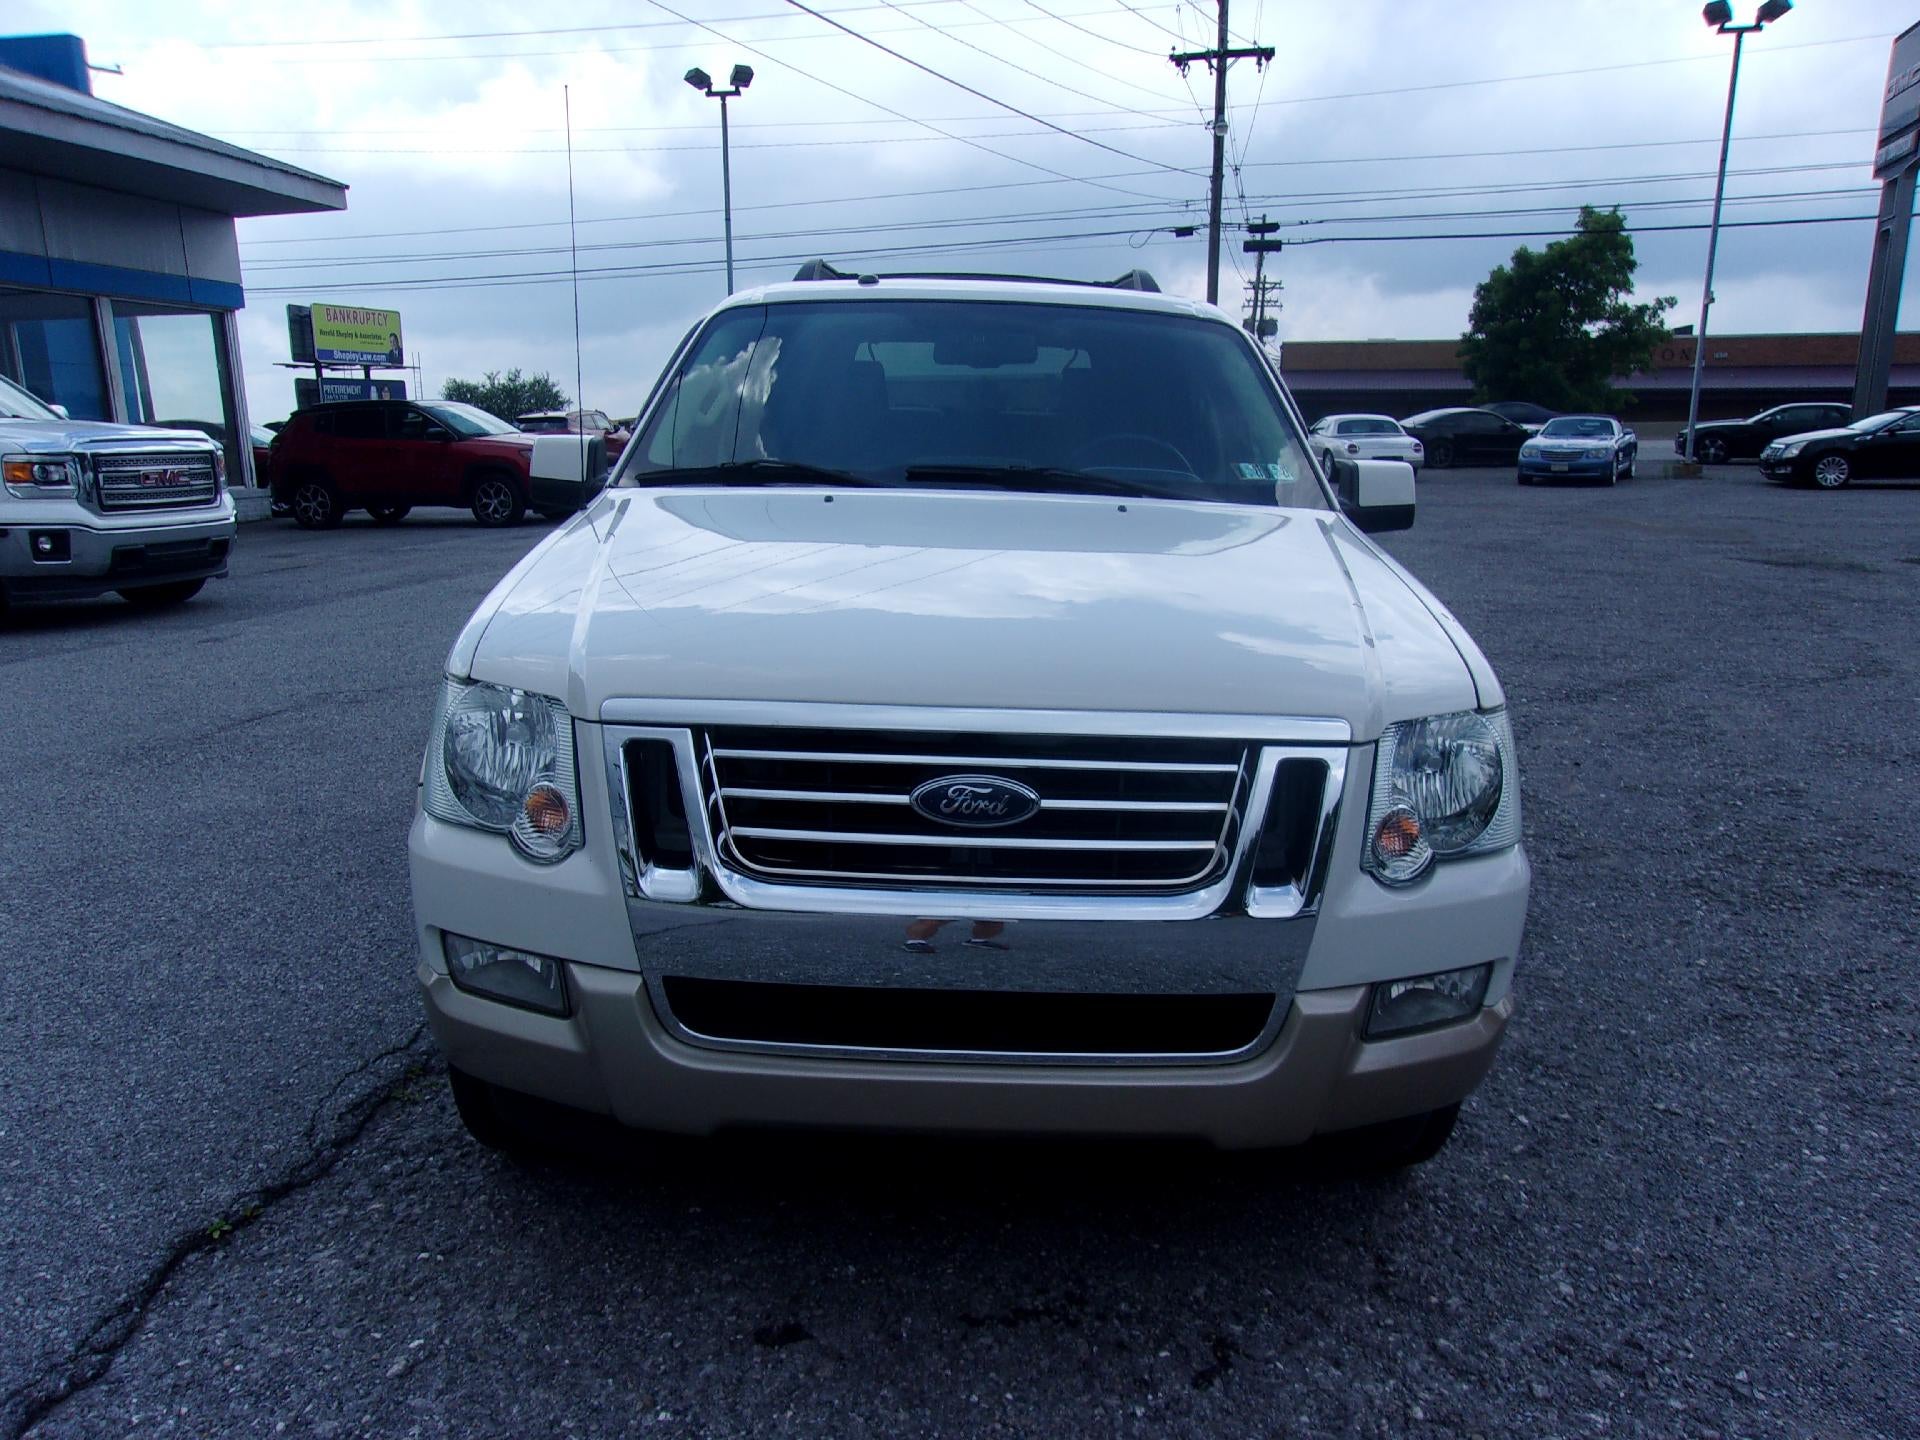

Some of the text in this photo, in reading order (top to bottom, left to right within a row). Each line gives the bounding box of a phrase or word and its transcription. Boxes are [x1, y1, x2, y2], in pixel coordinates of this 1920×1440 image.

[325, 307, 388, 327] BANKRUPTCY
[333, 350, 387, 363] ShepleyLaw.com
[140, 468, 191, 487] GMC
[940, 784, 1010, 815] Ford
